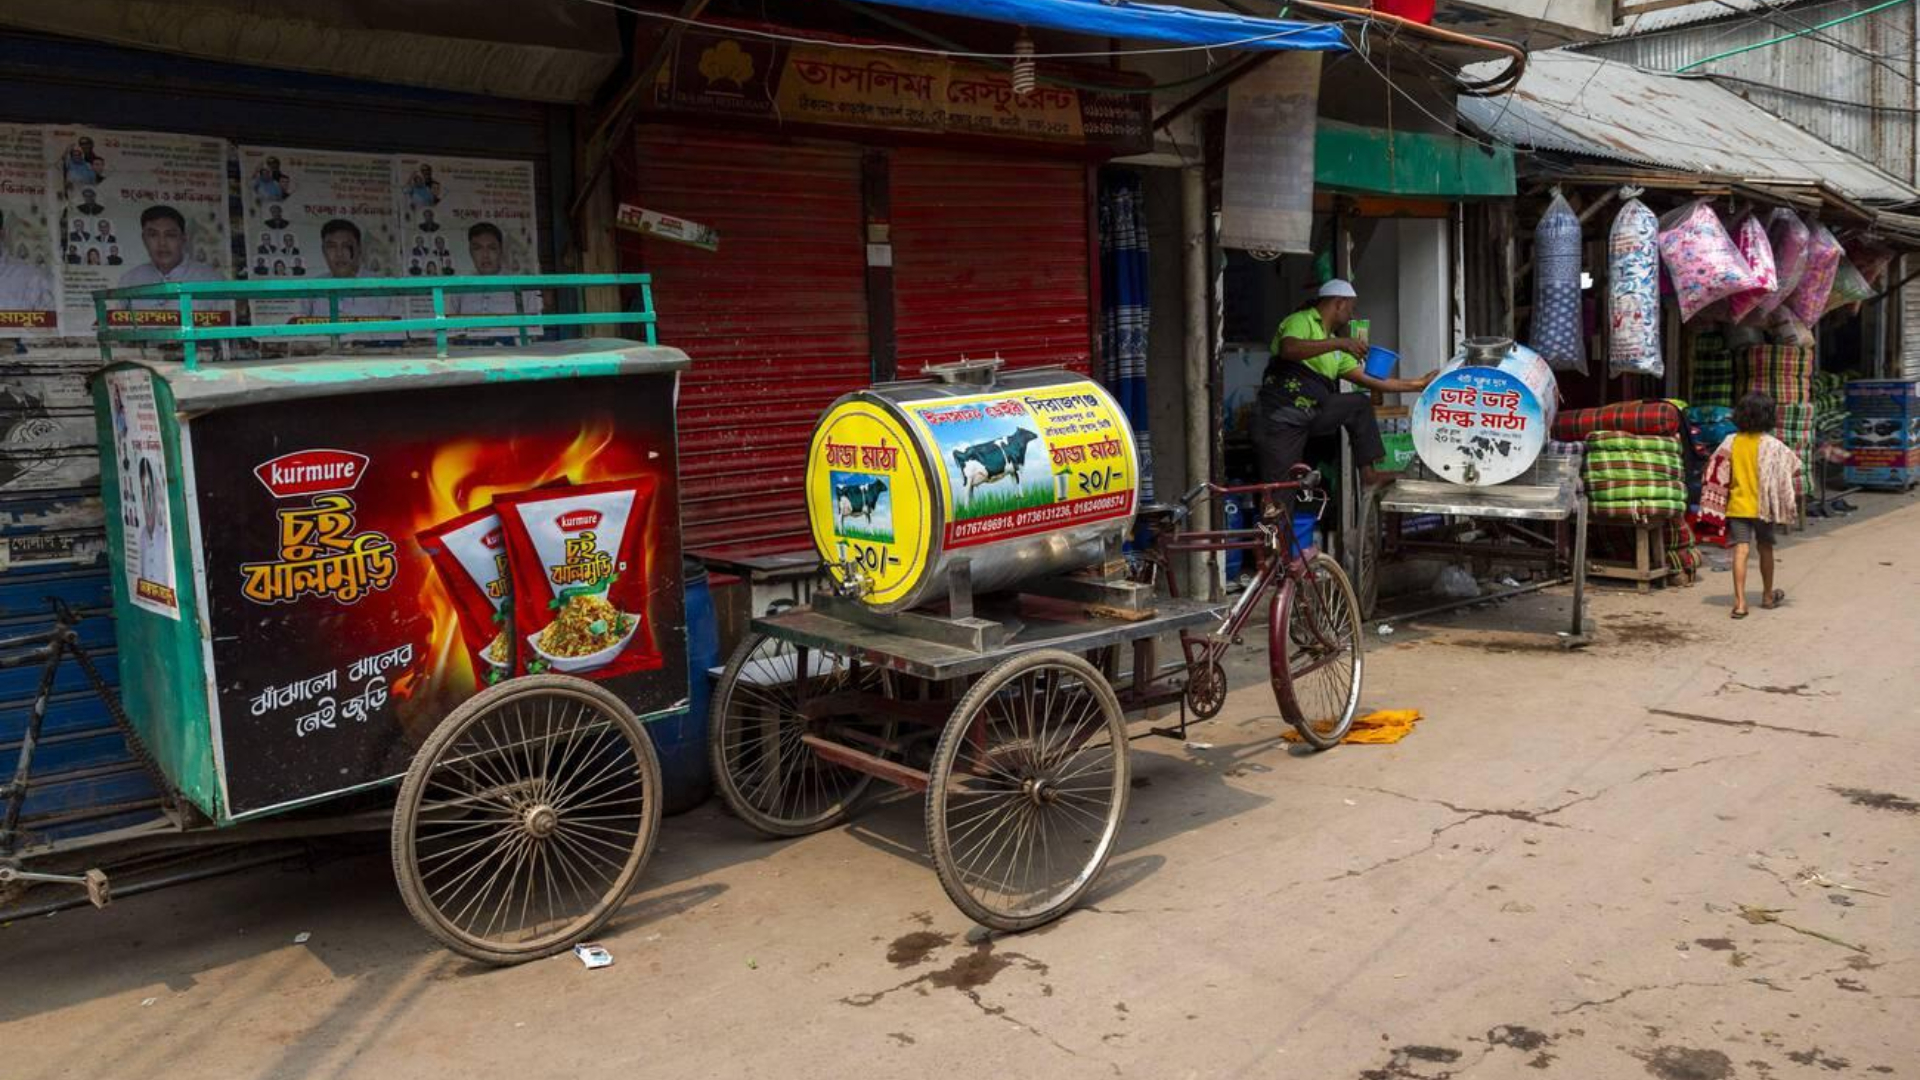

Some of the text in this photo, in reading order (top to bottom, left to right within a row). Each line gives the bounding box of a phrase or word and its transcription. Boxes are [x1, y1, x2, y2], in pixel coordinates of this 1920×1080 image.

[792, 58, 936, 101] তাসলিমা
[0, 180, 46, 195] ভিনন্দন
[1025, 392, 1100, 415] সিরাজগঞ্জ
[1440, 385, 1520, 411] ভাই ভাই
[1430, 404, 1527, 431] মিল্ক মাঠা
[861, 437, 899, 471] মাঠা
[1087, 434, 1123, 461] মাঠা
[271, 460, 355, 486] kurmure
[1078, 465, 1123, 496] ২০/-
[278, 494, 356, 562] চুই
[561, 513, 598, 528] kurmure
[565, 531, 597, 564] চুই
[854, 543, 901, 577] ২০/-
[243, 533, 397, 602] ঝালমুড়ি
[551, 551, 612, 587] ঝালমুড়ি
[249, 642, 414, 716] ঝাঁঝালো ঝালের
[295, 676, 388, 738] নেই জুড়ি
